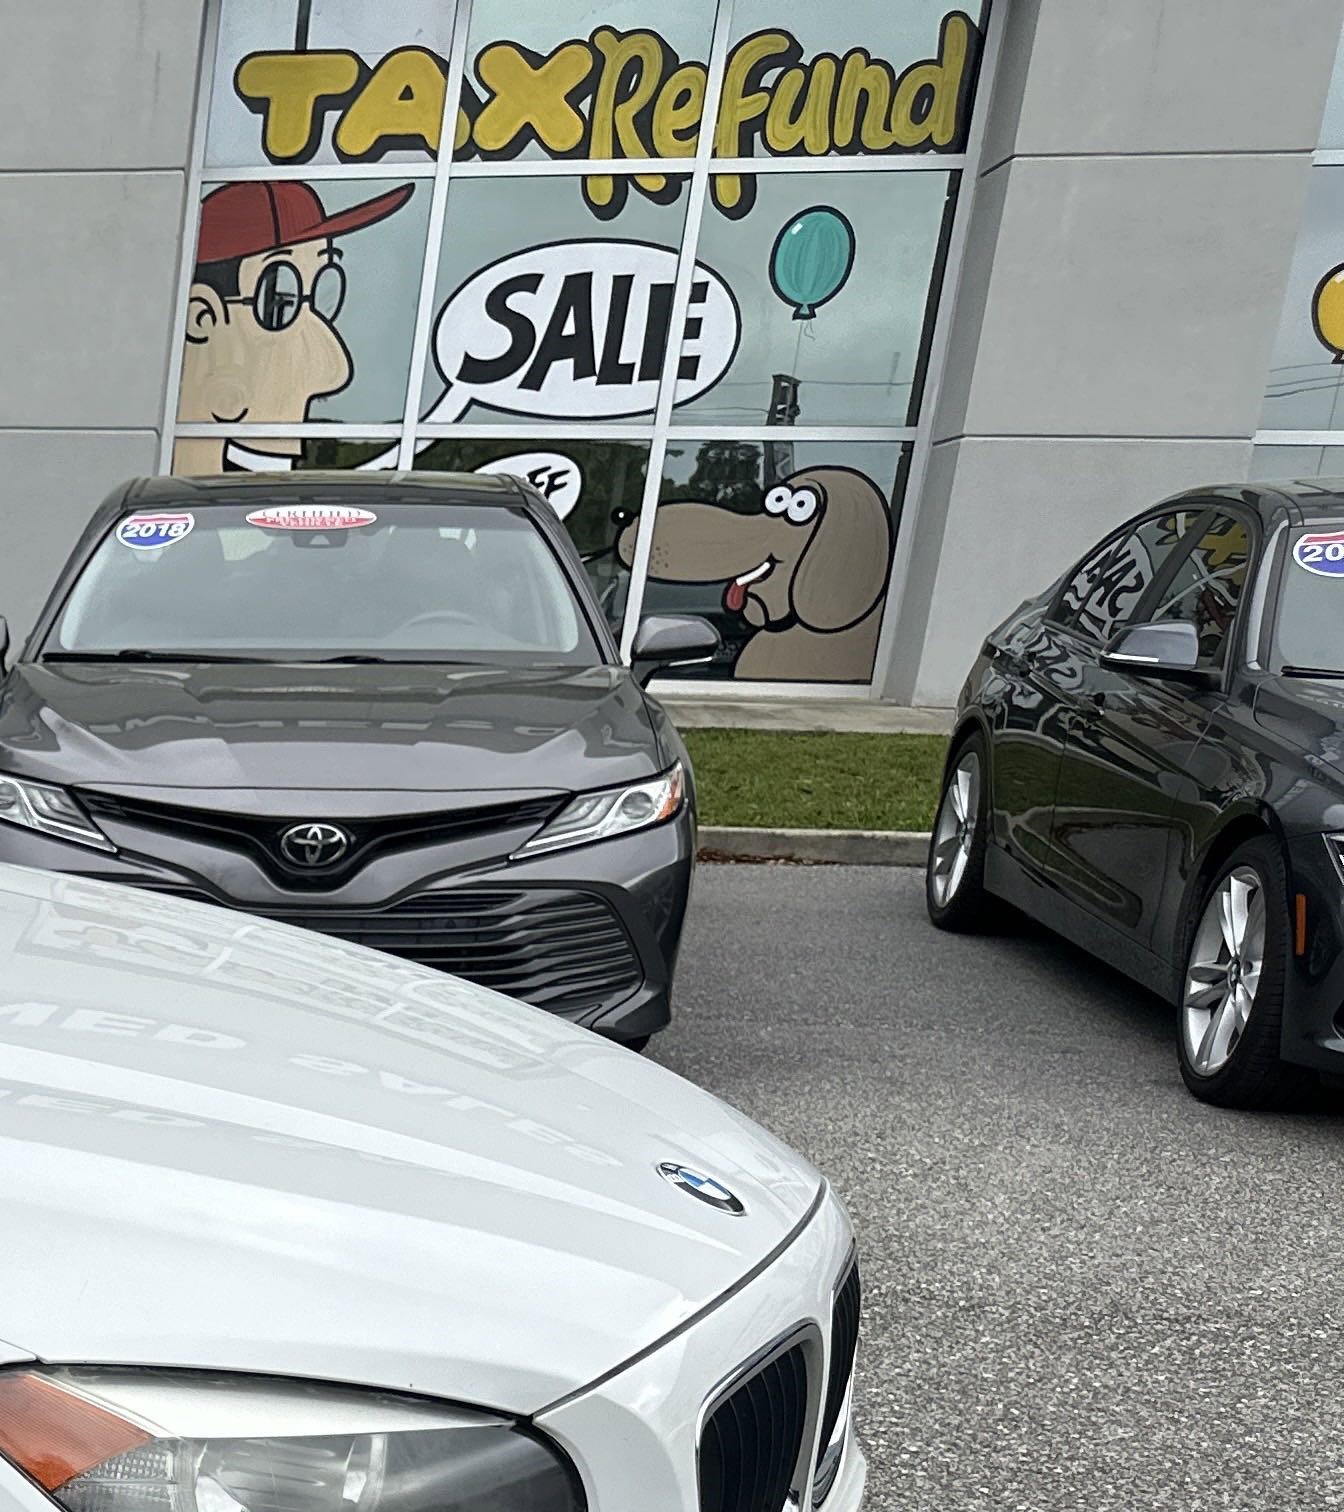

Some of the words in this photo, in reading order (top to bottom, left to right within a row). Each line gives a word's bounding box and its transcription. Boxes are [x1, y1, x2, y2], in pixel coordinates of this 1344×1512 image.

[234, 42, 594, 161] TAX
[459, 271, 713, 391] SALE
[122, 522, 186, 539] 2018
[1302, 543, 1344, 563] 20
